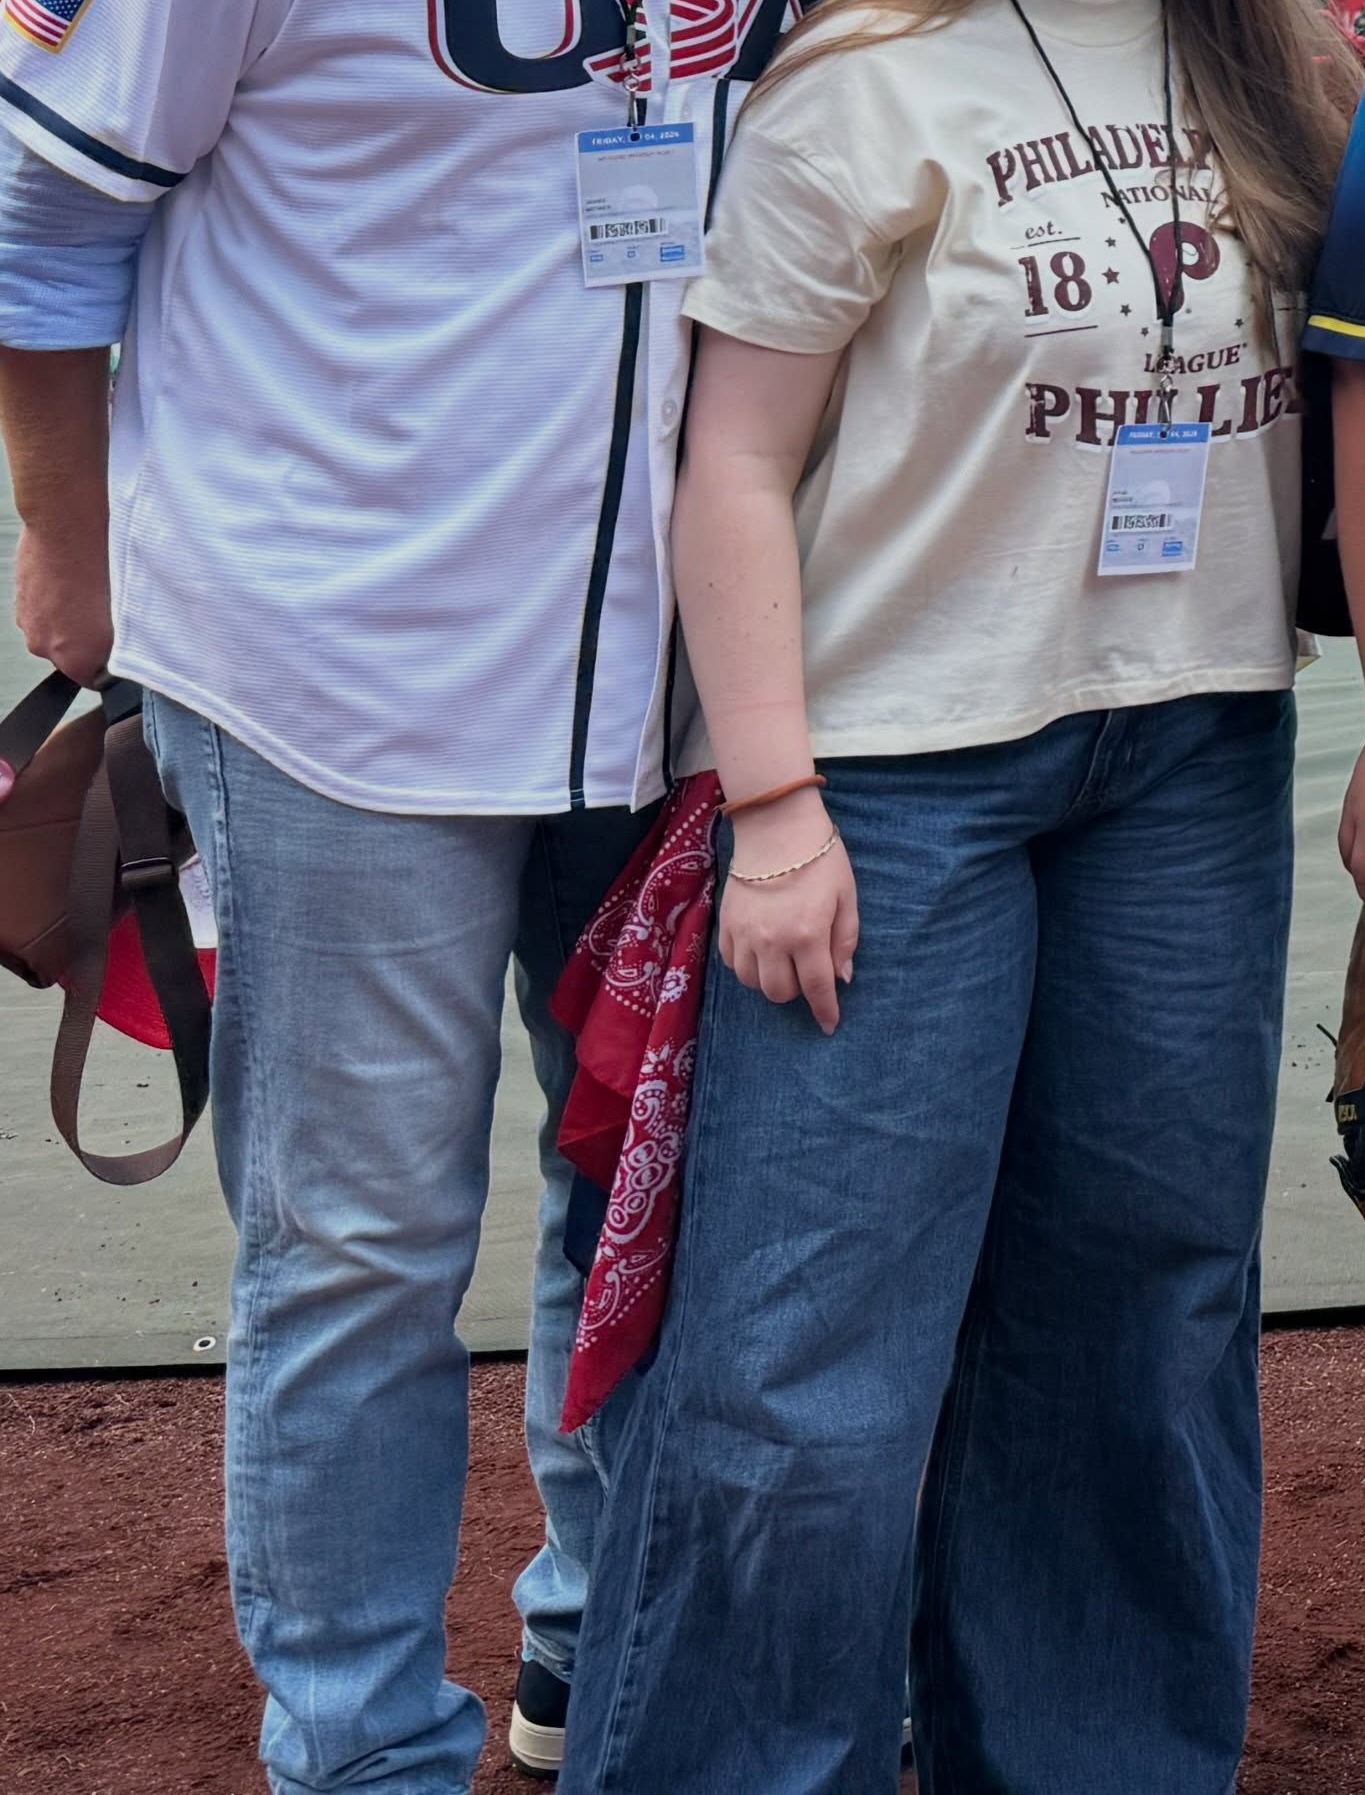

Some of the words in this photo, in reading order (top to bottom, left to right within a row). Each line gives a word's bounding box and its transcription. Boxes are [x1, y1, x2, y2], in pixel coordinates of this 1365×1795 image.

[1101, 184, 1220, 208] NATIONAL
[1024, 220, 1063, 240] est.
[1018, 251, 1093, 318] 18
[1143, 345, 1241, 375] LEAGUE
